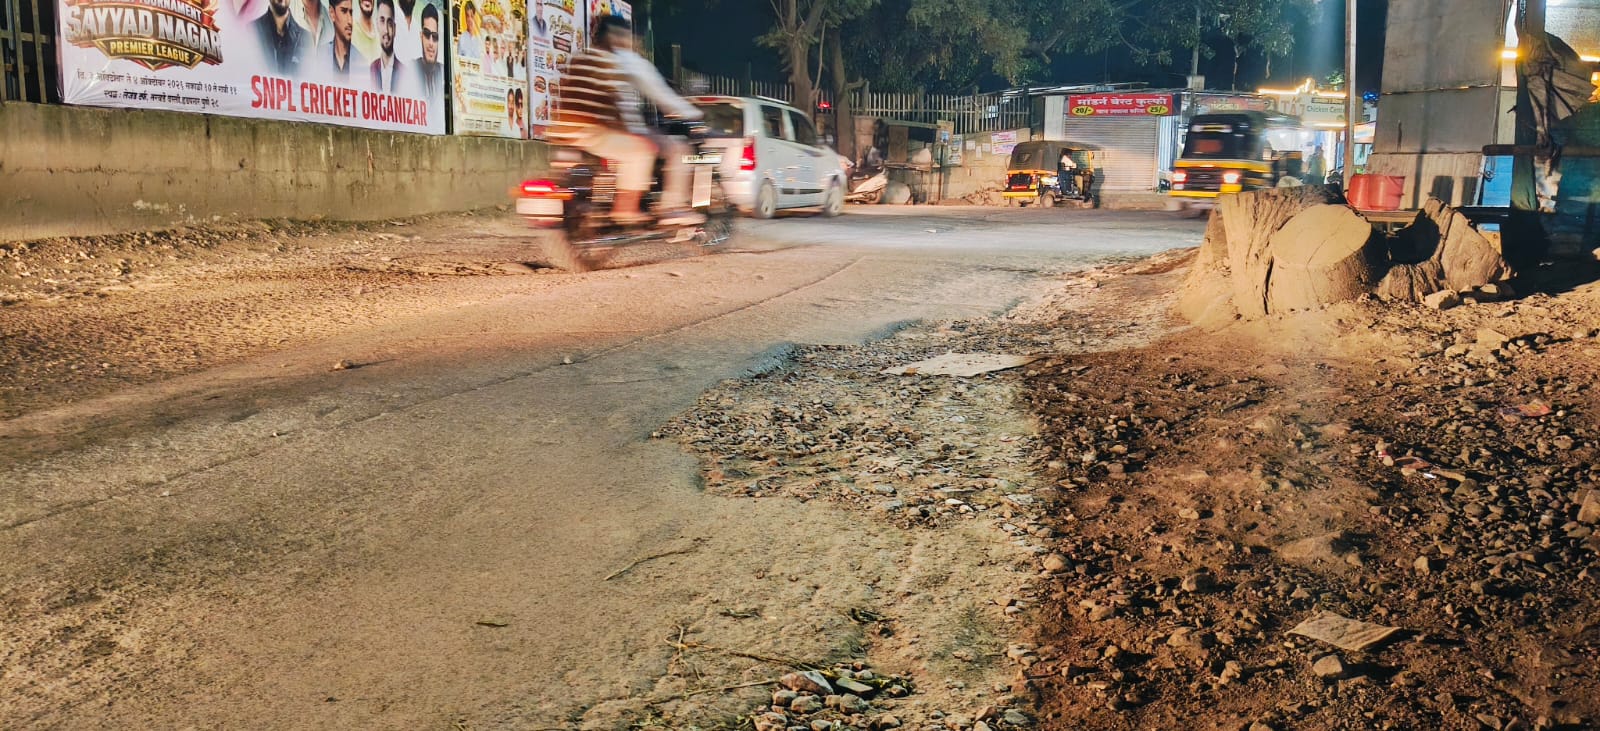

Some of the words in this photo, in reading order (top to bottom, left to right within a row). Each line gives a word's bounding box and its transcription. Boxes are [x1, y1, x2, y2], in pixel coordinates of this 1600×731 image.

[139, 0, 202, 21] URNAMENT
[66, 5, 153, 39] SAYYAD
[158, 13, 223, 59] NAGAR
[110, 40, 154, 55] PREMIER
[156, 44, 190, 64] LEAGUE
[140, 75, 166, 86] ऑक्टोबर
[251, 75, 297, 112] SNPL
[300, 82, 358, 118] CRICKET
[361, 91, 428, 126] ORGANIZAR
[1135, 96, 1168, 108] कुल्फी
[1075, 105, 1092, 114] 20/-
[1150, 105, 1166, 114] 25/-
[1306, 105, 1329, 113] Chicken
